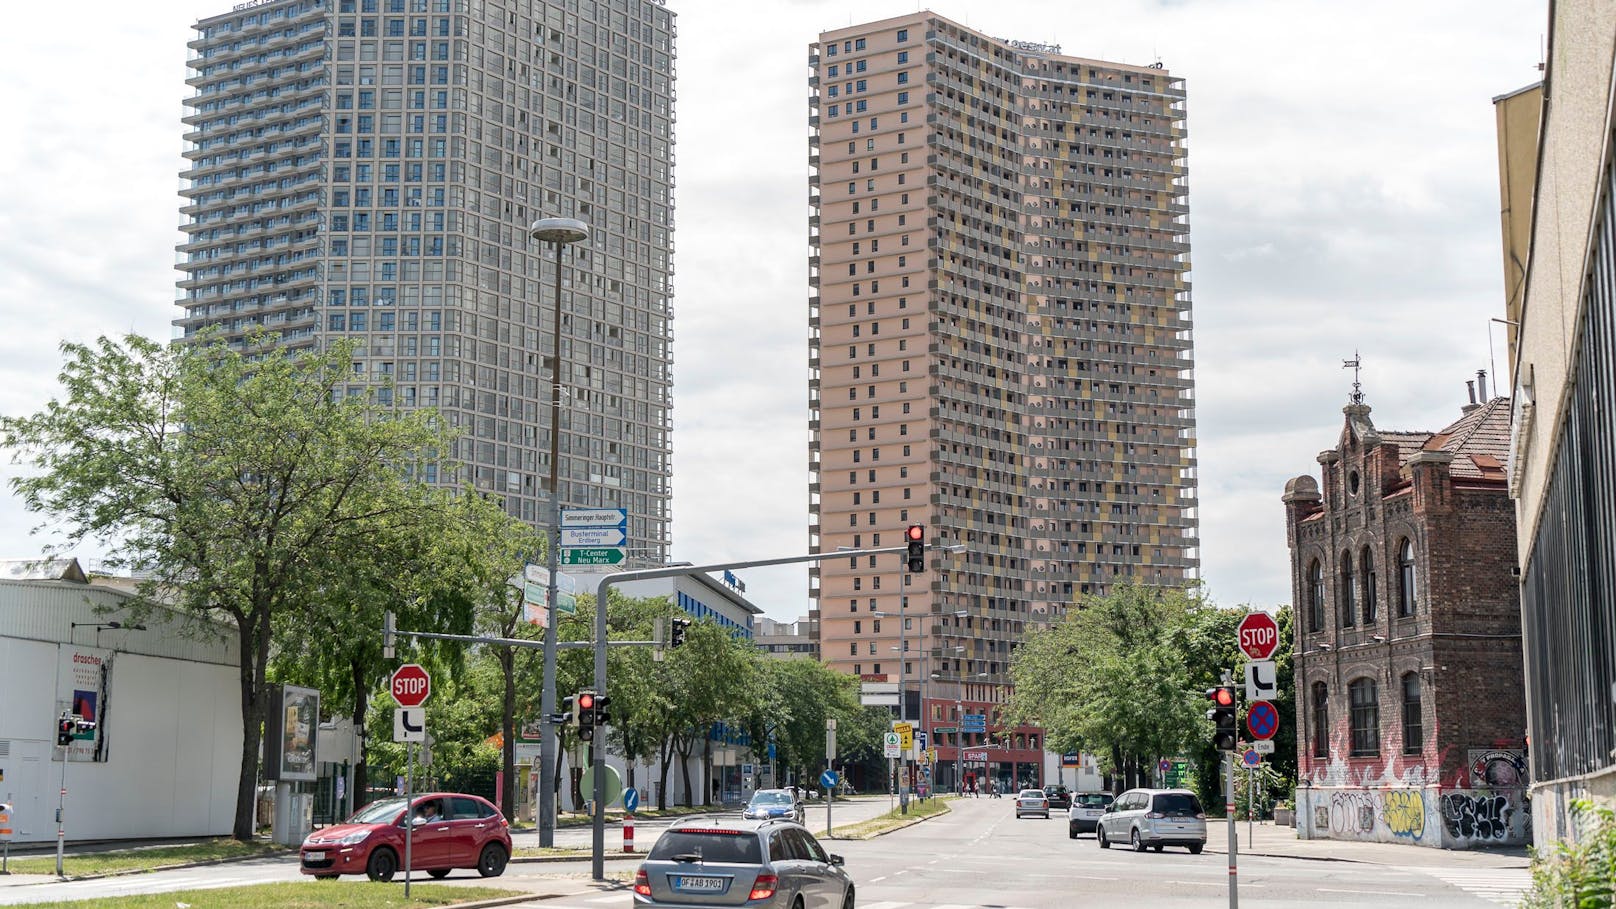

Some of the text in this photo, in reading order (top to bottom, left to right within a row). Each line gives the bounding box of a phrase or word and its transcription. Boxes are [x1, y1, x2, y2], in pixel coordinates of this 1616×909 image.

[1242, 627, 1274, 646] STOP
[395, 677, 426, 695] STOP
[695, 879, 704, 887] AB
[704, 880, 722, 888] 1901
